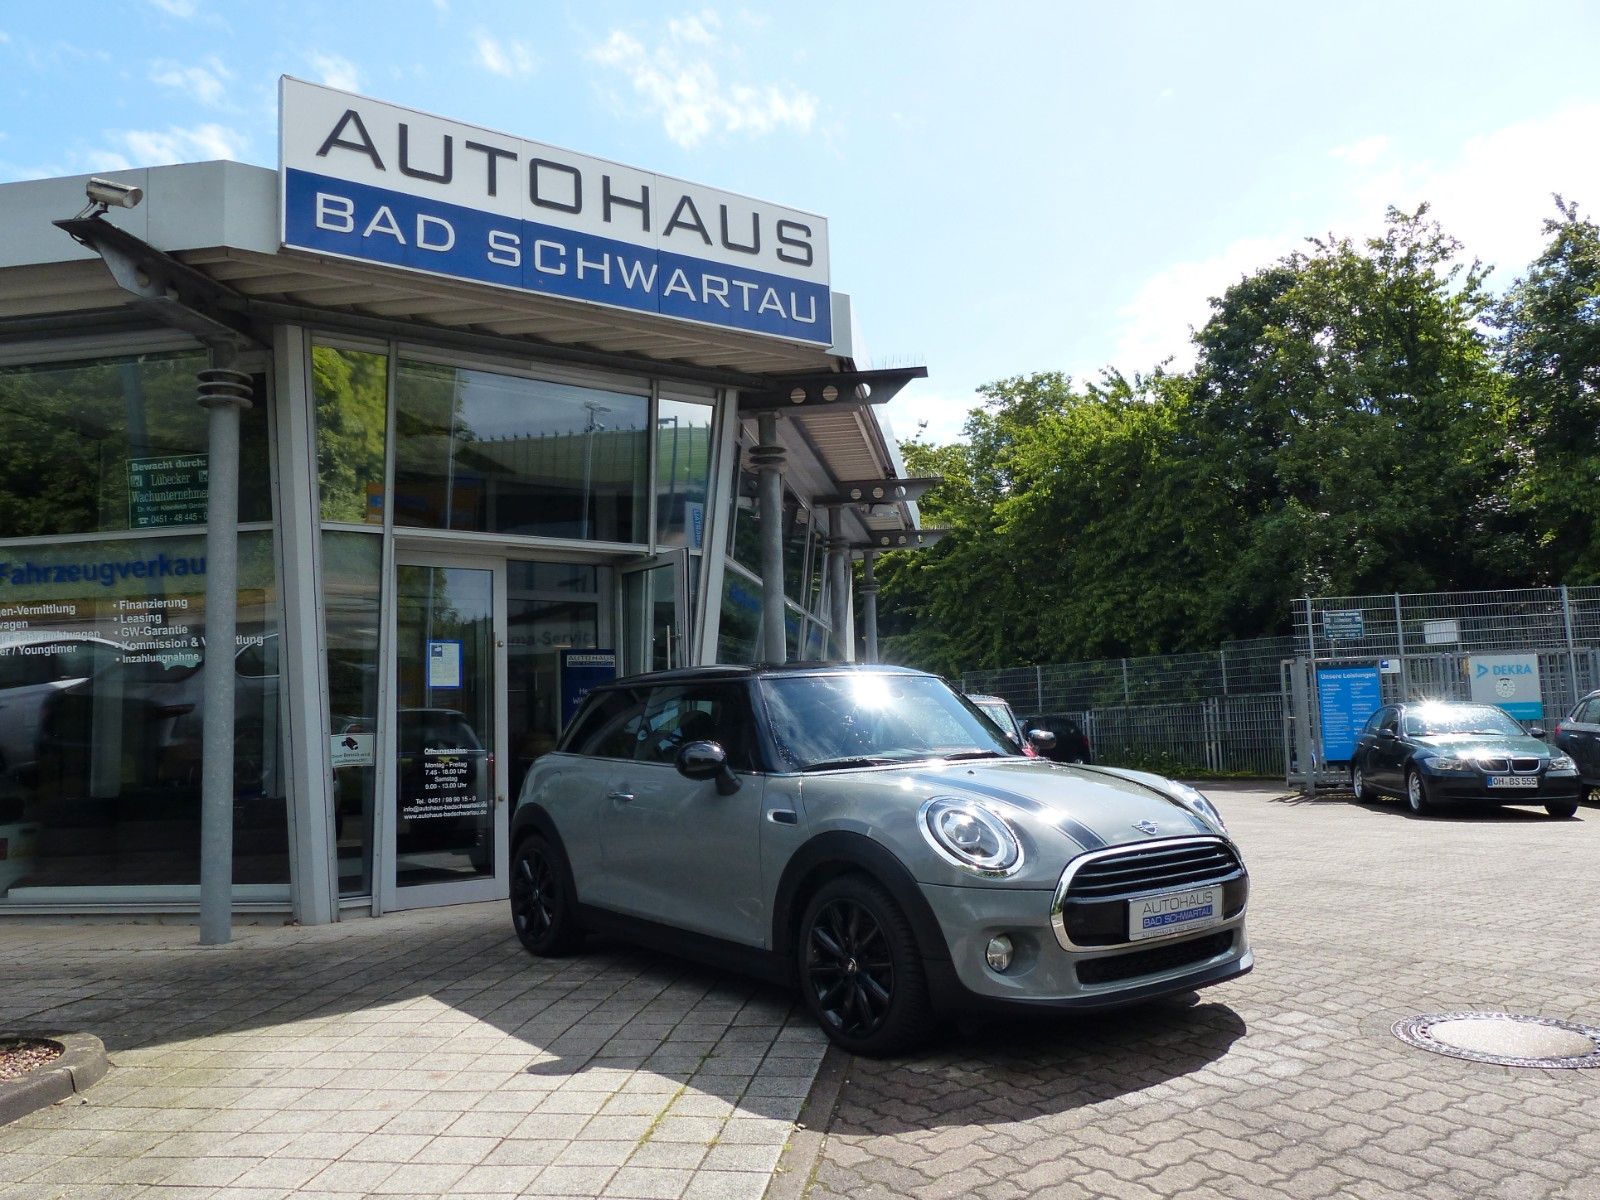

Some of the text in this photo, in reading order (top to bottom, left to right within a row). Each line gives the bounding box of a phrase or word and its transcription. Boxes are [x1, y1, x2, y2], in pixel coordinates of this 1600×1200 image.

[316, 109, 814, 267] AUTOHAUS
[315, 192, 817, 324] BAD SCHWARTAU
[131, 459, 207, 471] Bewacht durch:
[150, 473, 191, 486] Lübecker
[150, 514, 168, 524] 0451
[119, 598, 188, 611] Finanzierung
[120, 613, 162, 625] Leasing
[121, 625, 188, 637] GW-Garantie
[18, 644, 77, 657] Youngtimer
[121, 637, 188, 651] Kommission
[122, 652, 200, 664] Inzahlungnahme
[1492, 664, 1532, 675] DEKRA
[1493, 777, 1537, 786] OH BS 555
[1142, 891, 1213, 915] AUTOHAUS
[1144, 908, 1212, 927] BAD SCHWARTAU
